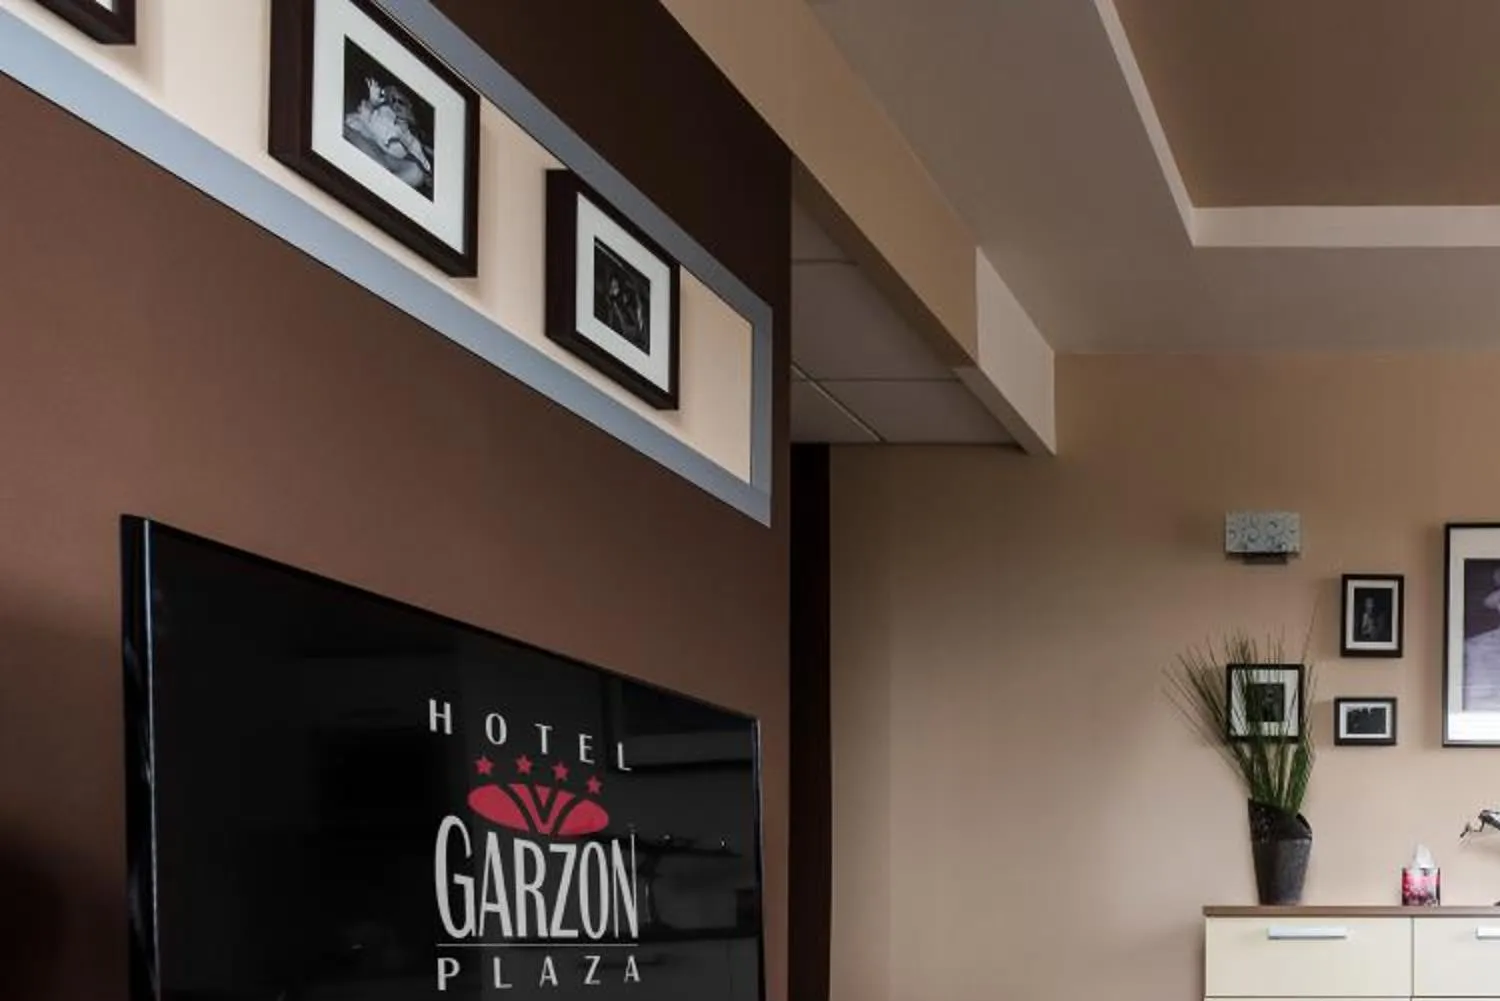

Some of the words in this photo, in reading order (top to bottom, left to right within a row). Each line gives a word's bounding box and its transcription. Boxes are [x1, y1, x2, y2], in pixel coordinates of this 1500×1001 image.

[429, 699, 631, 771] HOTEL
[435, 815, 639, 939] GARZON
[437, 955, 640, 990] PLAZA
